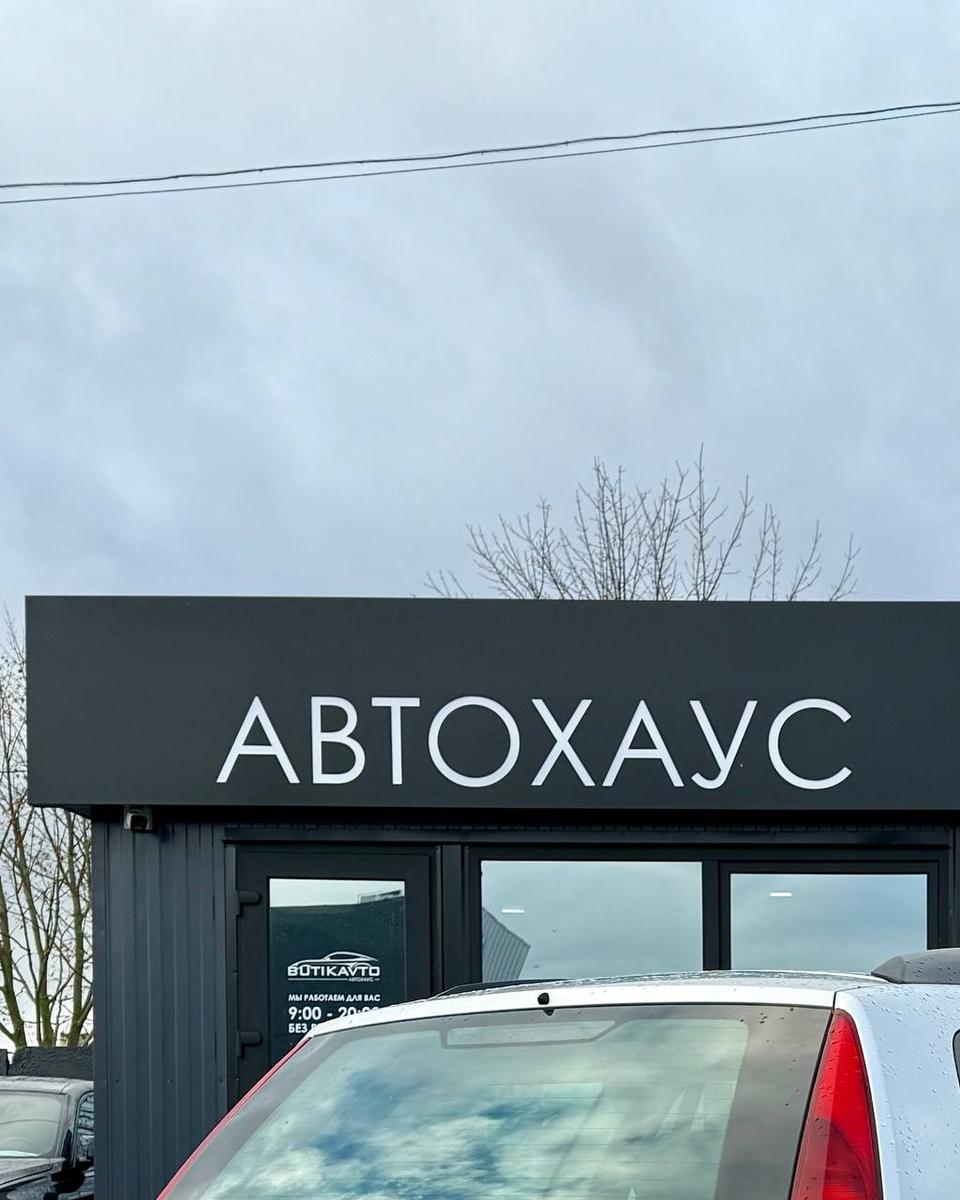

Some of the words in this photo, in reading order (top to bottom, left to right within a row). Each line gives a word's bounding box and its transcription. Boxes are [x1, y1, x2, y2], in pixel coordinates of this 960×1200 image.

[216, 695, 853, 790] АВТОХАУС
[287, 965, 380, 976] BUTIKAVTO
[346, 994, 362, 1002] ДЛЯ
[288, 1006, 321, 1020] 9:00
[288, 1023, 308, 1033] БЕЗ
